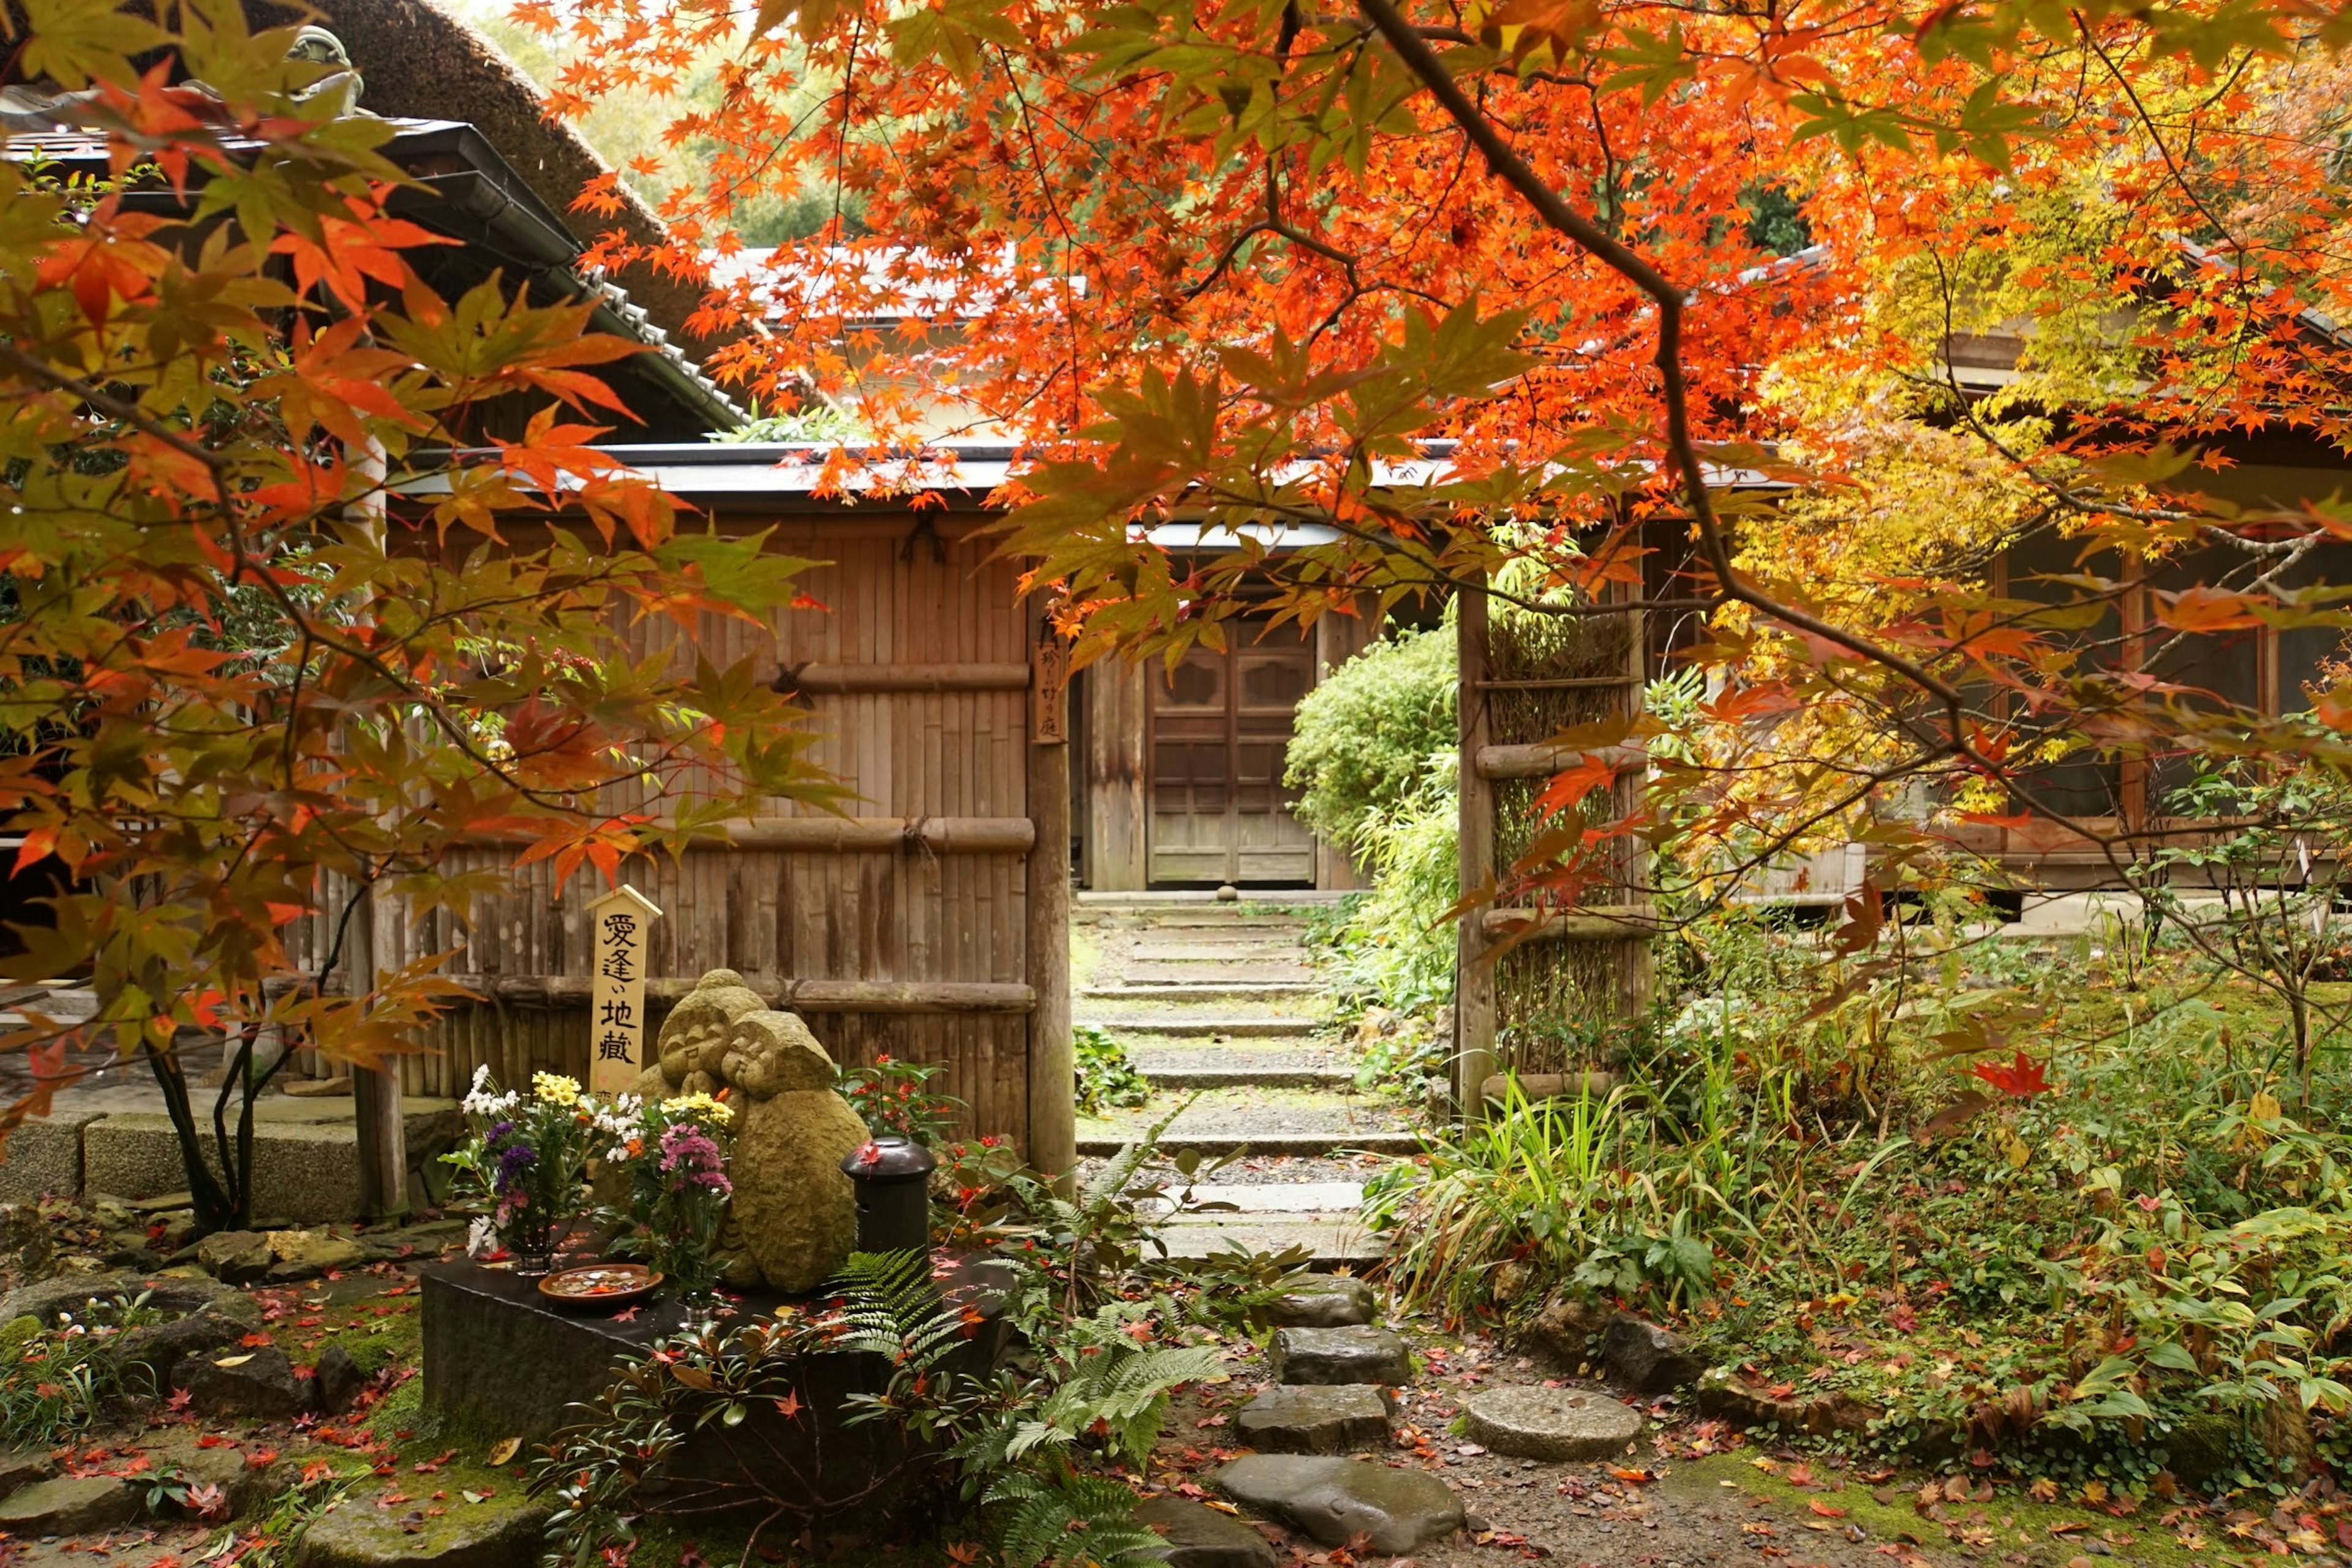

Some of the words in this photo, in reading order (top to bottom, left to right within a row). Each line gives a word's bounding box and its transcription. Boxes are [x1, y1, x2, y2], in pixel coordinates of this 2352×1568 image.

[1039, 649, 1060, 736] 珍しい竹の庭
